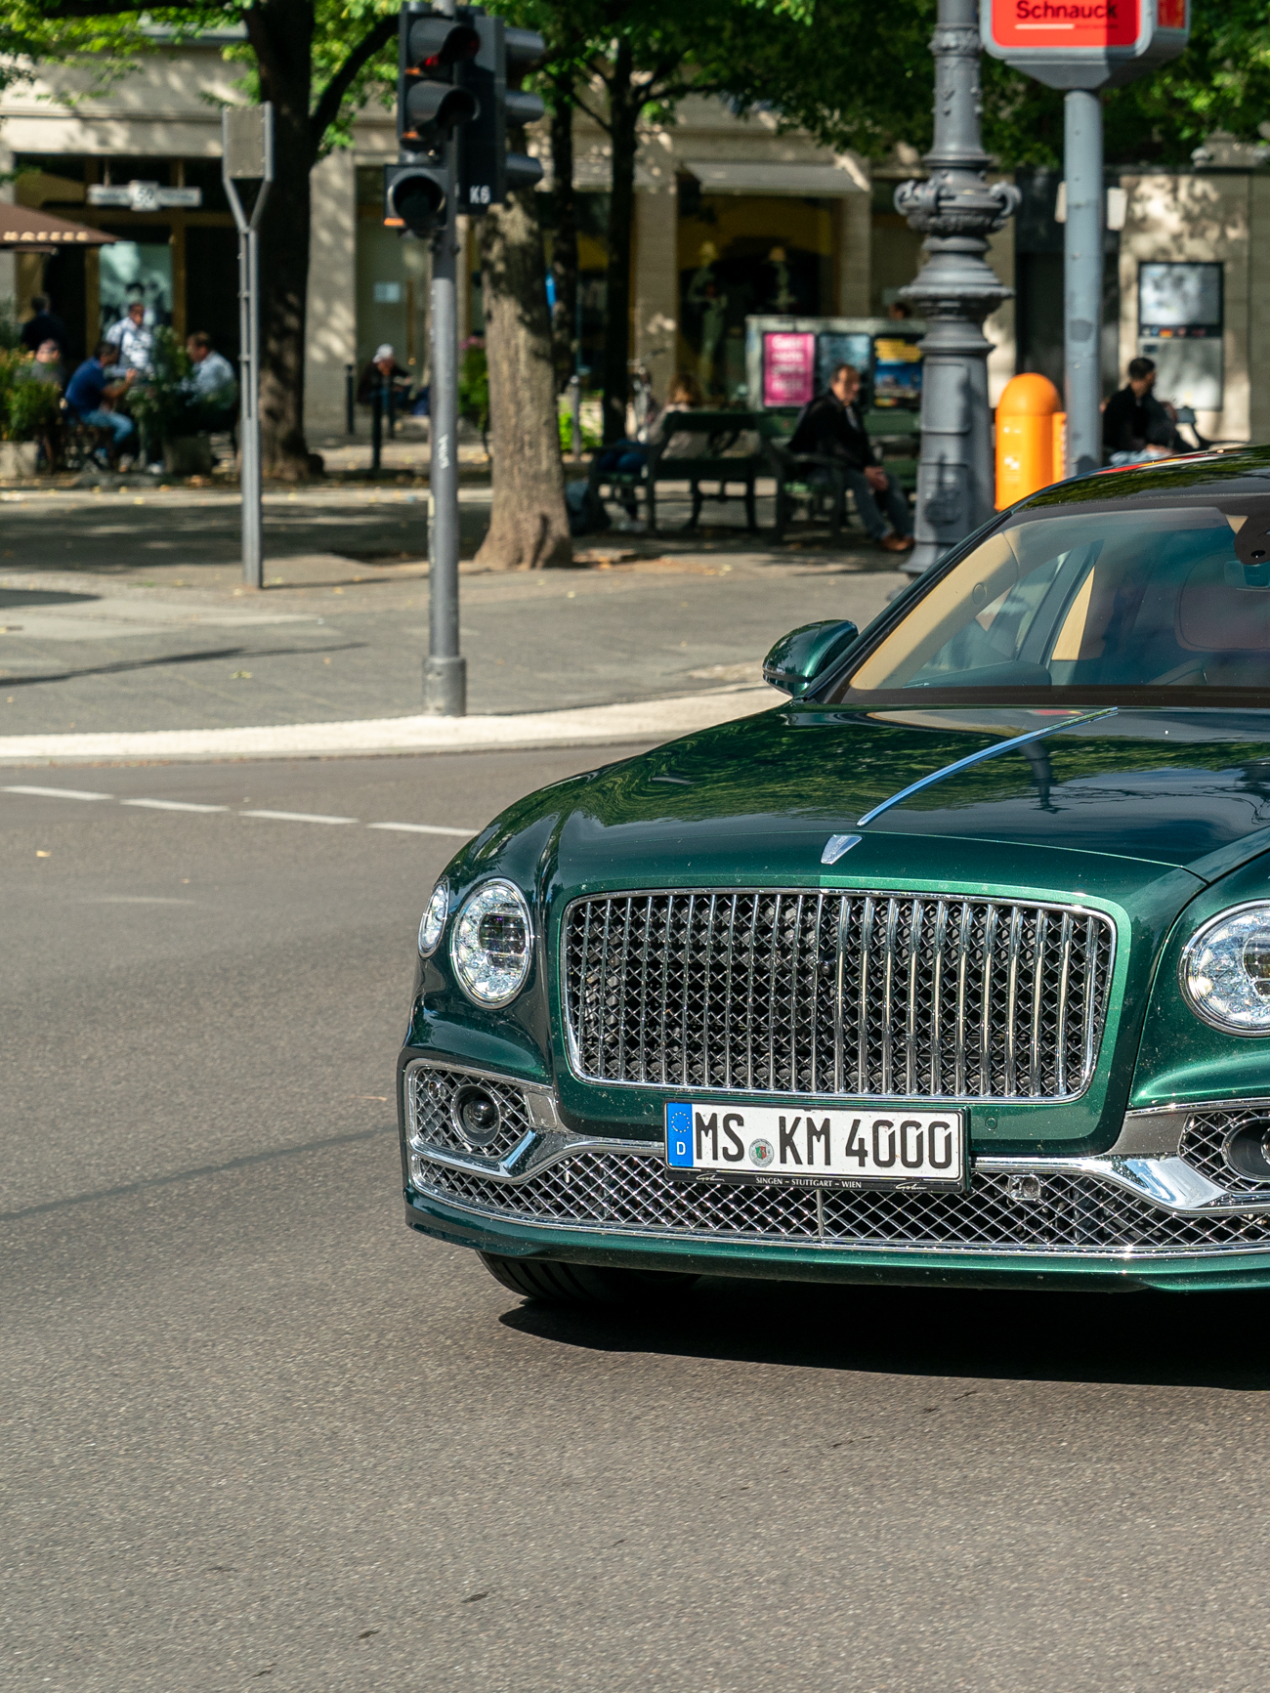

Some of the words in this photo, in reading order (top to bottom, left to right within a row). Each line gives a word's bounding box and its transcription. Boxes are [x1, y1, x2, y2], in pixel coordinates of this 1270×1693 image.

[1016, 0, 1118, 19] Schnauck
[676, 1141, 686, 1155] D
[695, 1112, 745, 1162] MS
[778, 1115, 831, 1166] KM
[845, 1118, 952, 1169] 4000
[755, 1176, 783, 1185] SINGEN
[791, 1178, 833, 1187] STUTTGART
[841, 1180, 862, 1188] WIEN
